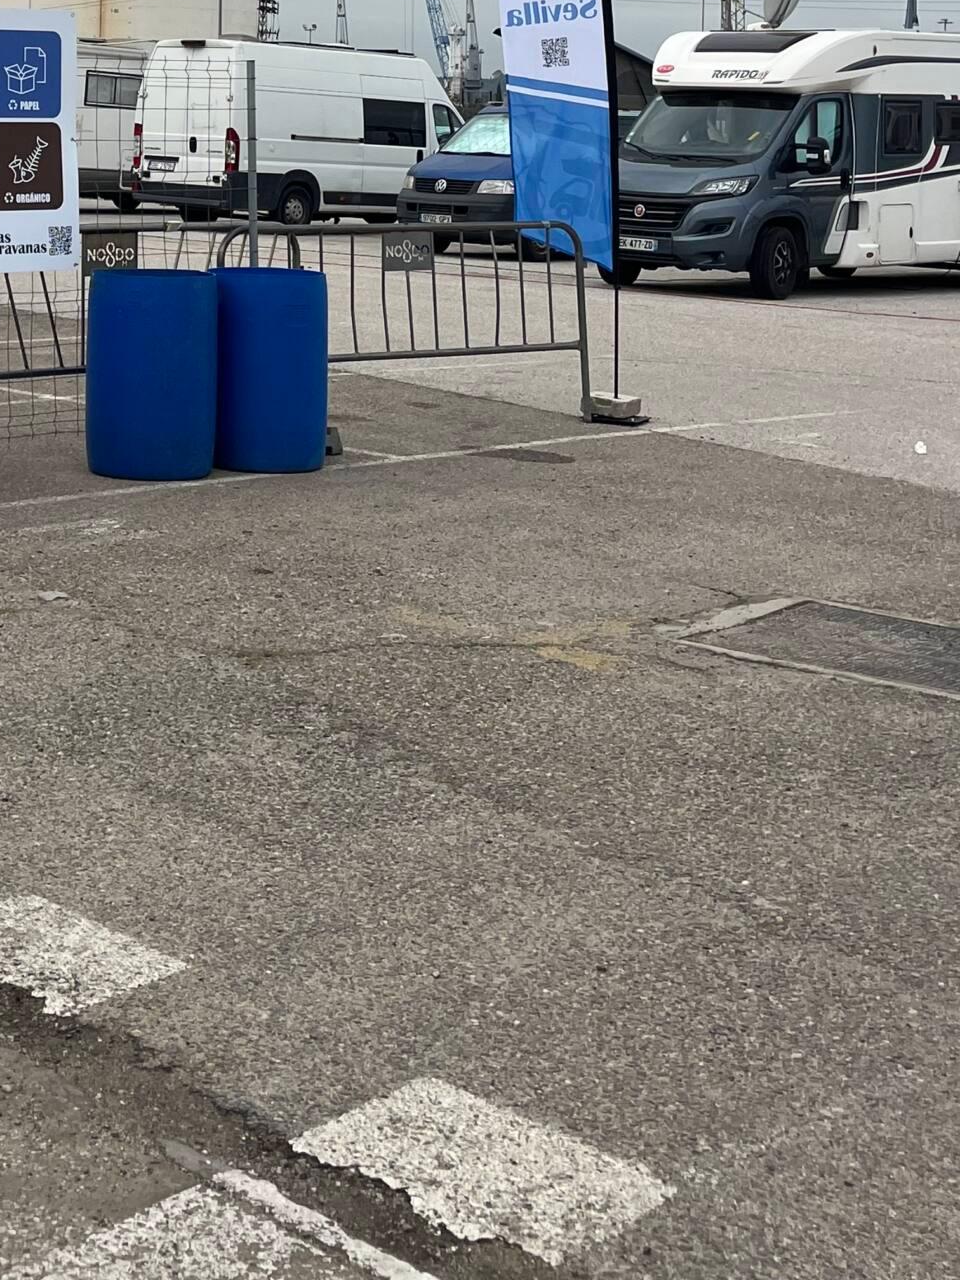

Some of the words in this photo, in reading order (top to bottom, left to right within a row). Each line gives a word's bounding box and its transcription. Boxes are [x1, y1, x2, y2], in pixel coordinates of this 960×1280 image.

[711, 69, 759, 79] RAPIDO
[20, 100, 40, 111] PAPEL
[15, 192, 51, 204] ORGÁNICO
